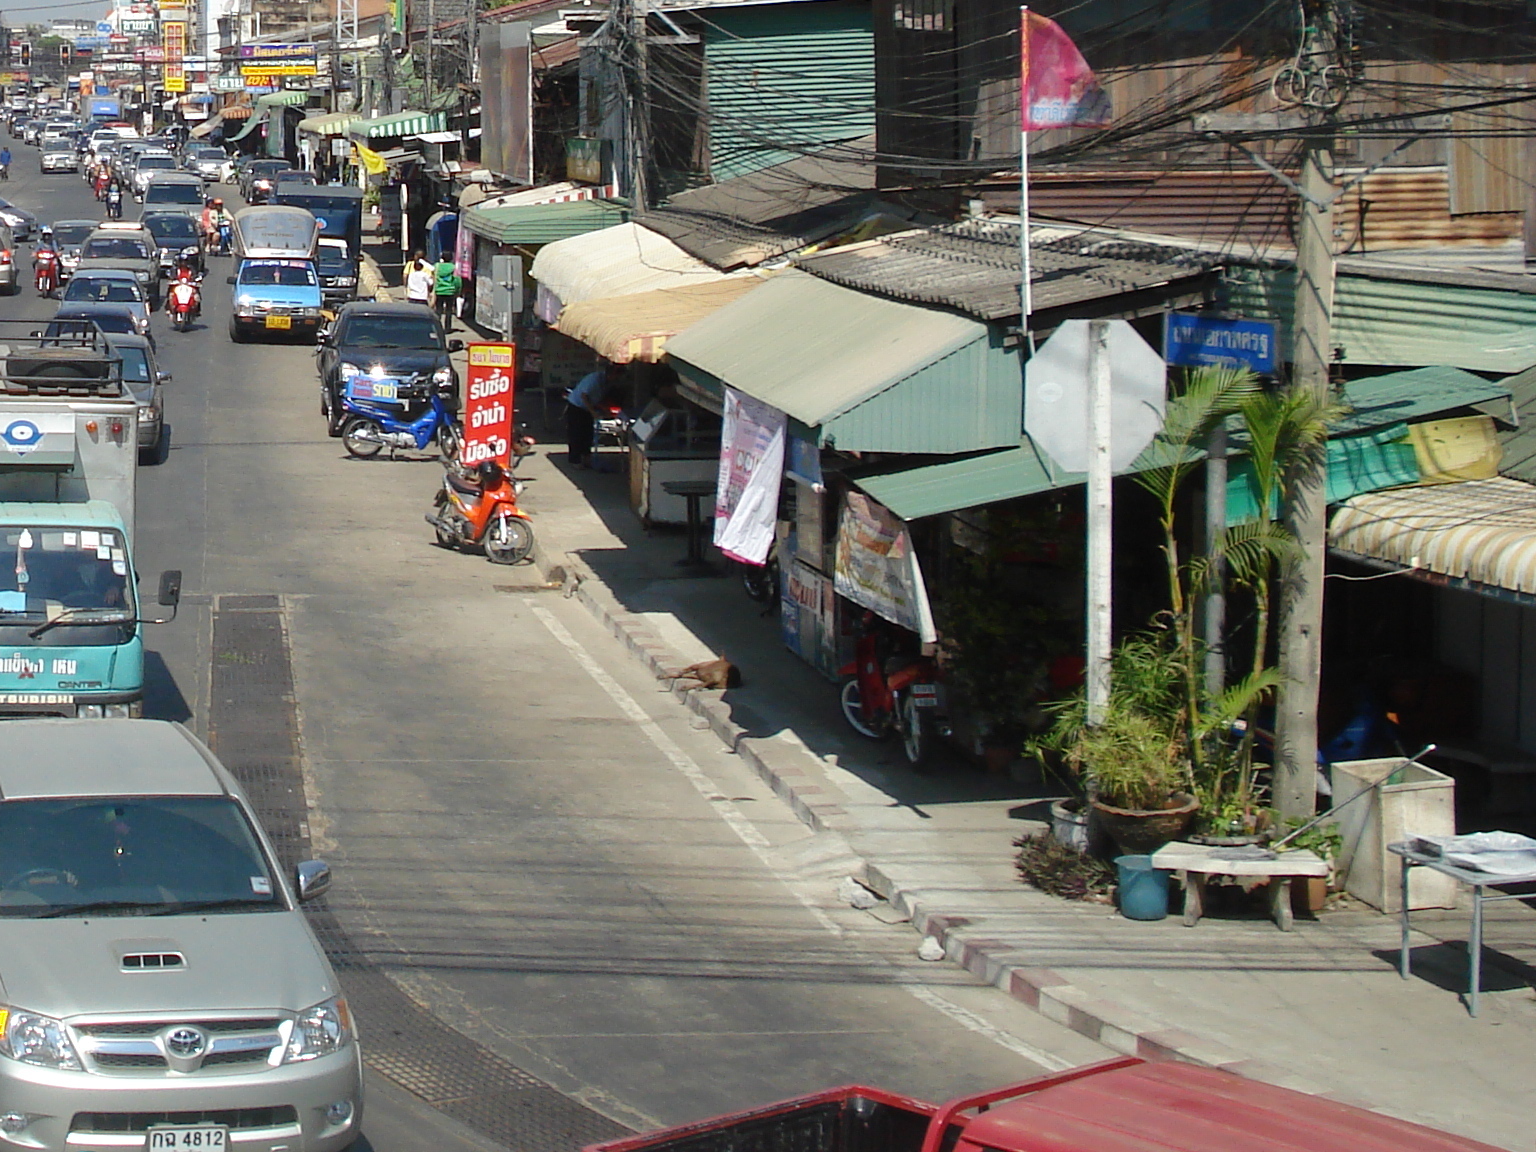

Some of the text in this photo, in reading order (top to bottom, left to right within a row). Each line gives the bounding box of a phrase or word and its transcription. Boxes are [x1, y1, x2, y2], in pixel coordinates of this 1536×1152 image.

[469, 367, 510, 401] รับซื้อ
[472, 401, 506, 428] จำนำ
[57, 681, 103, 689] CANTER
[152, 1131, 223, 1148] กฉ 4812
